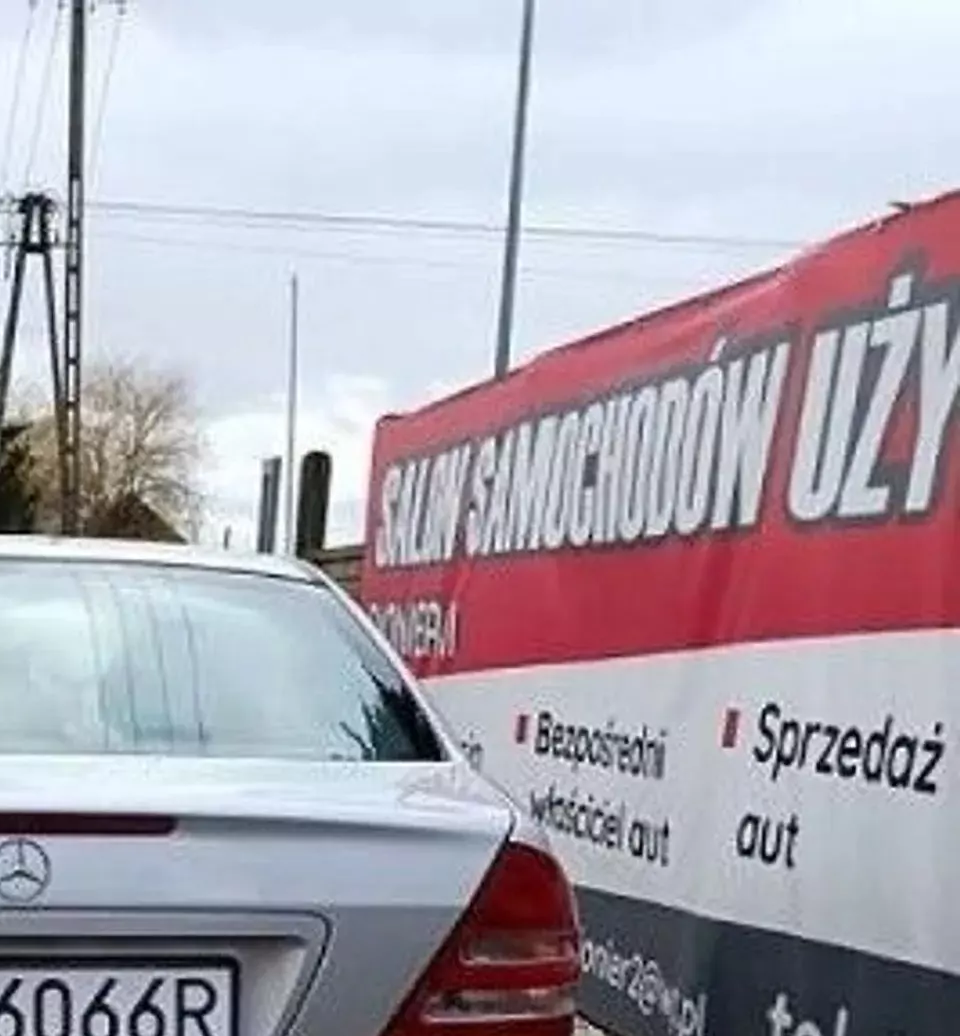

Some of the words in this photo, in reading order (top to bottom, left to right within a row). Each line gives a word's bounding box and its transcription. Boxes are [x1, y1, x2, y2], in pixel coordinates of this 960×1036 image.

[466, 337, 791, 557] SAMOCHODÓW
[534, 711, 667, 779] Bezpośredni
[752, 702, 945, 794] Sprzedaż
[529, 781, 626, 850] właściciel
[628, 817, 670, 867] aut
[736, 813, 799, 869] aut
